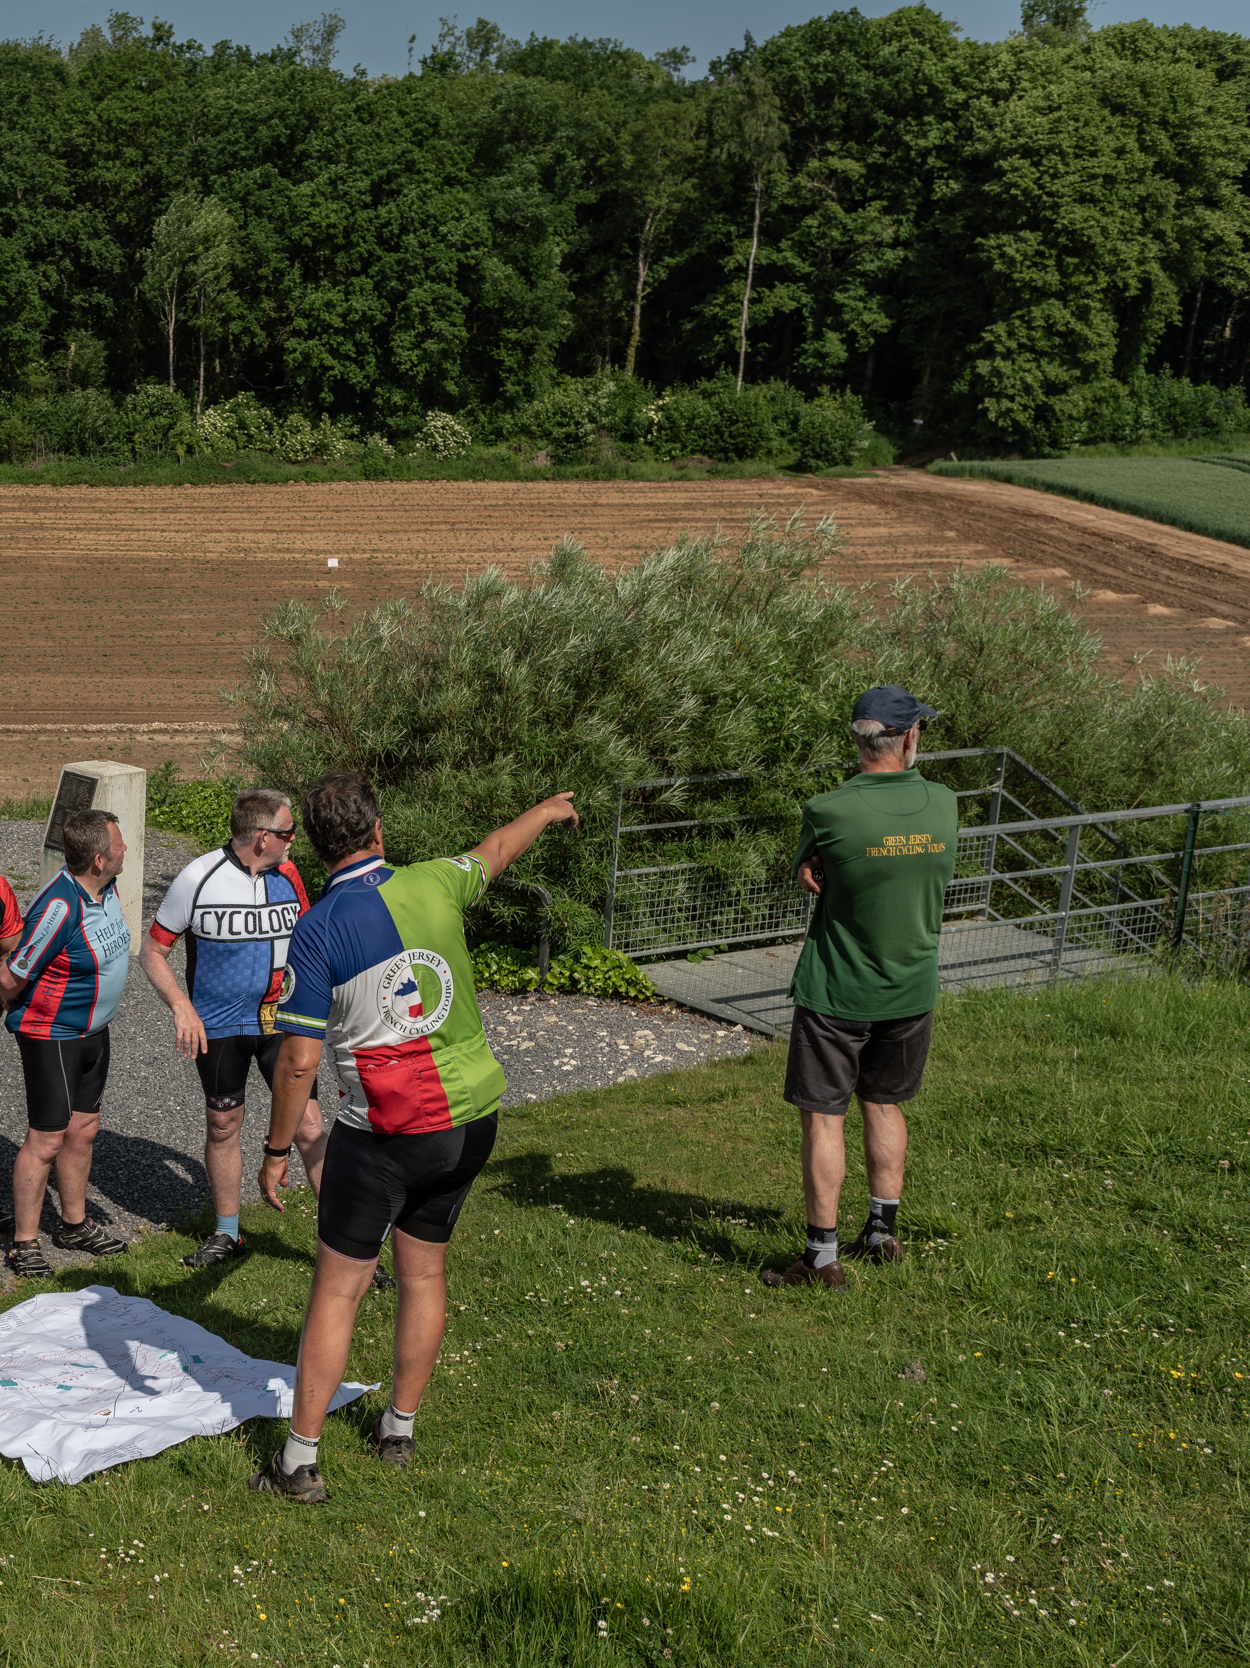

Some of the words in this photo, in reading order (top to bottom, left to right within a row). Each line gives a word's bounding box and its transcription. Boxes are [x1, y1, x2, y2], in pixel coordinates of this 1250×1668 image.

[866, 846, 895, 857] FRENCH
[896, 844, 925, 856] CYCLING
[927, 843, 946, 853] TOURS
[883, 836, 906, 846] GREEN
[908, 834, 932, 845] JERSEY
[49, 901, 63, 926] HEROES
[200, 905, 298, 936] CYCOLOGY
[95, 924, 114, 943] HELP
[115, 918, 125, 935] for
[101, 930, 130, 959] HEROES
[382, 956, 407, 990] GREEN
[408, 951, 443, 968] JERSEY
[29, 1009, 47, 1033] HLP
[41, 995, 51, 1012] for
[382, 1005, 408, 1033] FRENCH
[409, 1013, 445, 1035] CYCLING
[441, 979, 452, 1014] TOURS
